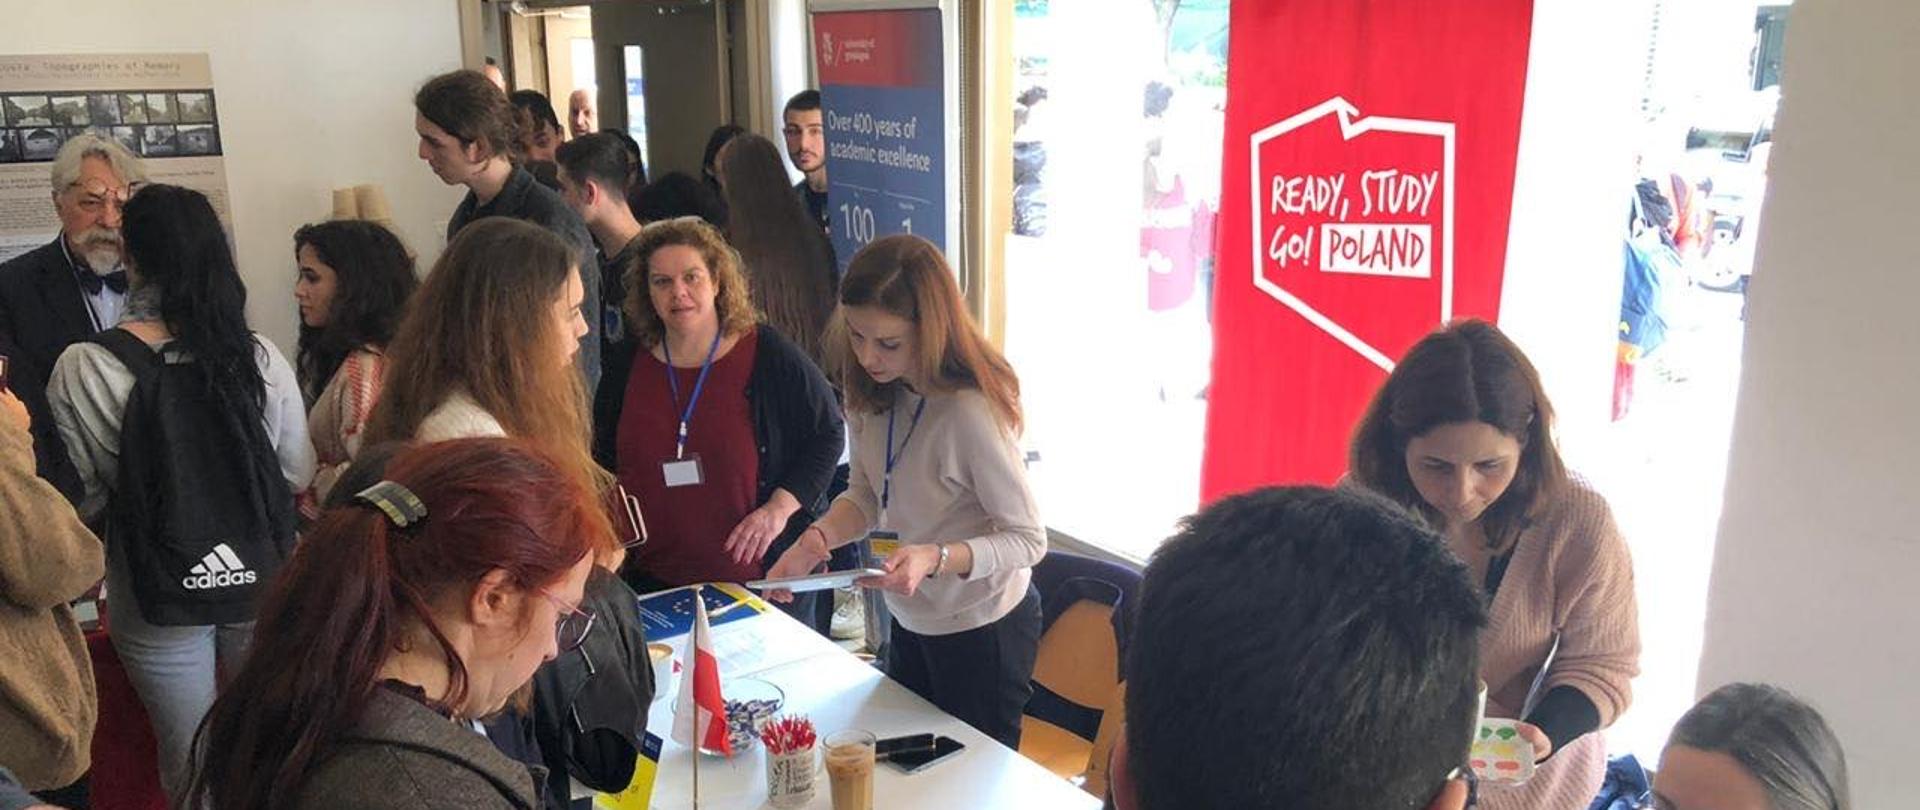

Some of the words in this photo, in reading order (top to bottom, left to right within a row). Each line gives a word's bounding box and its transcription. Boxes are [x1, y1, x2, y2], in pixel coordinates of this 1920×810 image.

[828, 110, 851, 131] Over
[853, 111, 872, 134] 400
[874, 119, 901, 140] years
[904, 116, 917, 139] of
[830, 140, 876, 163] academic
[878, 144, 931, 172] excellence
[1271, 173, 1349, 222] READY,
[1361, 169, 1439, 217] STUDY
[840, 203, 875, 244] 100
[1269, 224, 1315, 268] GO!
[1329, 228, 1425, 271] POLAND
[182, 570, 257, 590] adidas
